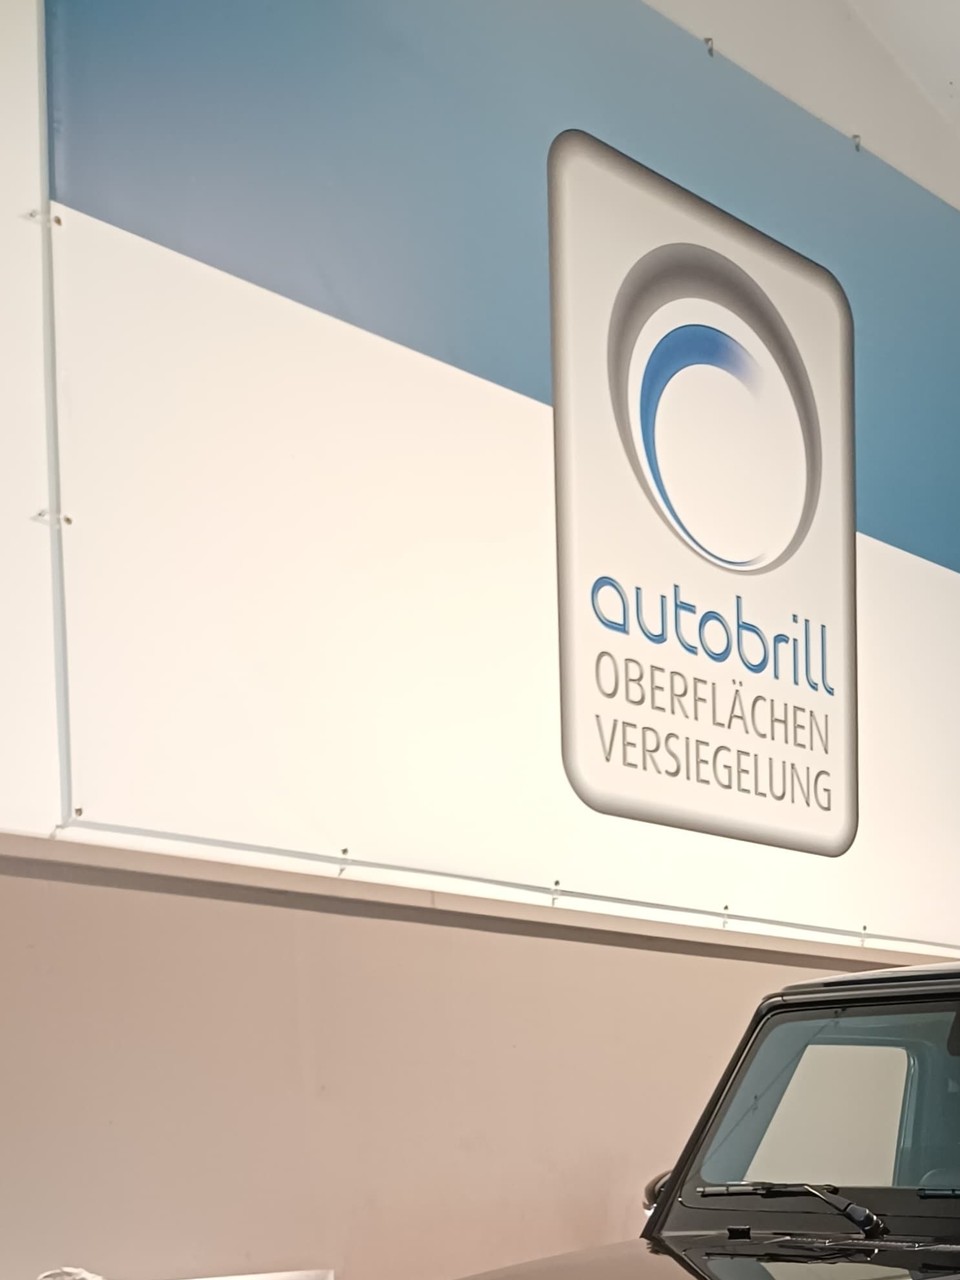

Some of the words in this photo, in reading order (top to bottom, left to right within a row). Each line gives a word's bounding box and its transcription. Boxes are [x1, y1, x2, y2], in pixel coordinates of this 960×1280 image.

[591, 576, 834, 696] autobrill
[595, 651, 829, 754] OBERFLÄCHEN
[595, 714, 832, 812] VERSIEGELUNG
